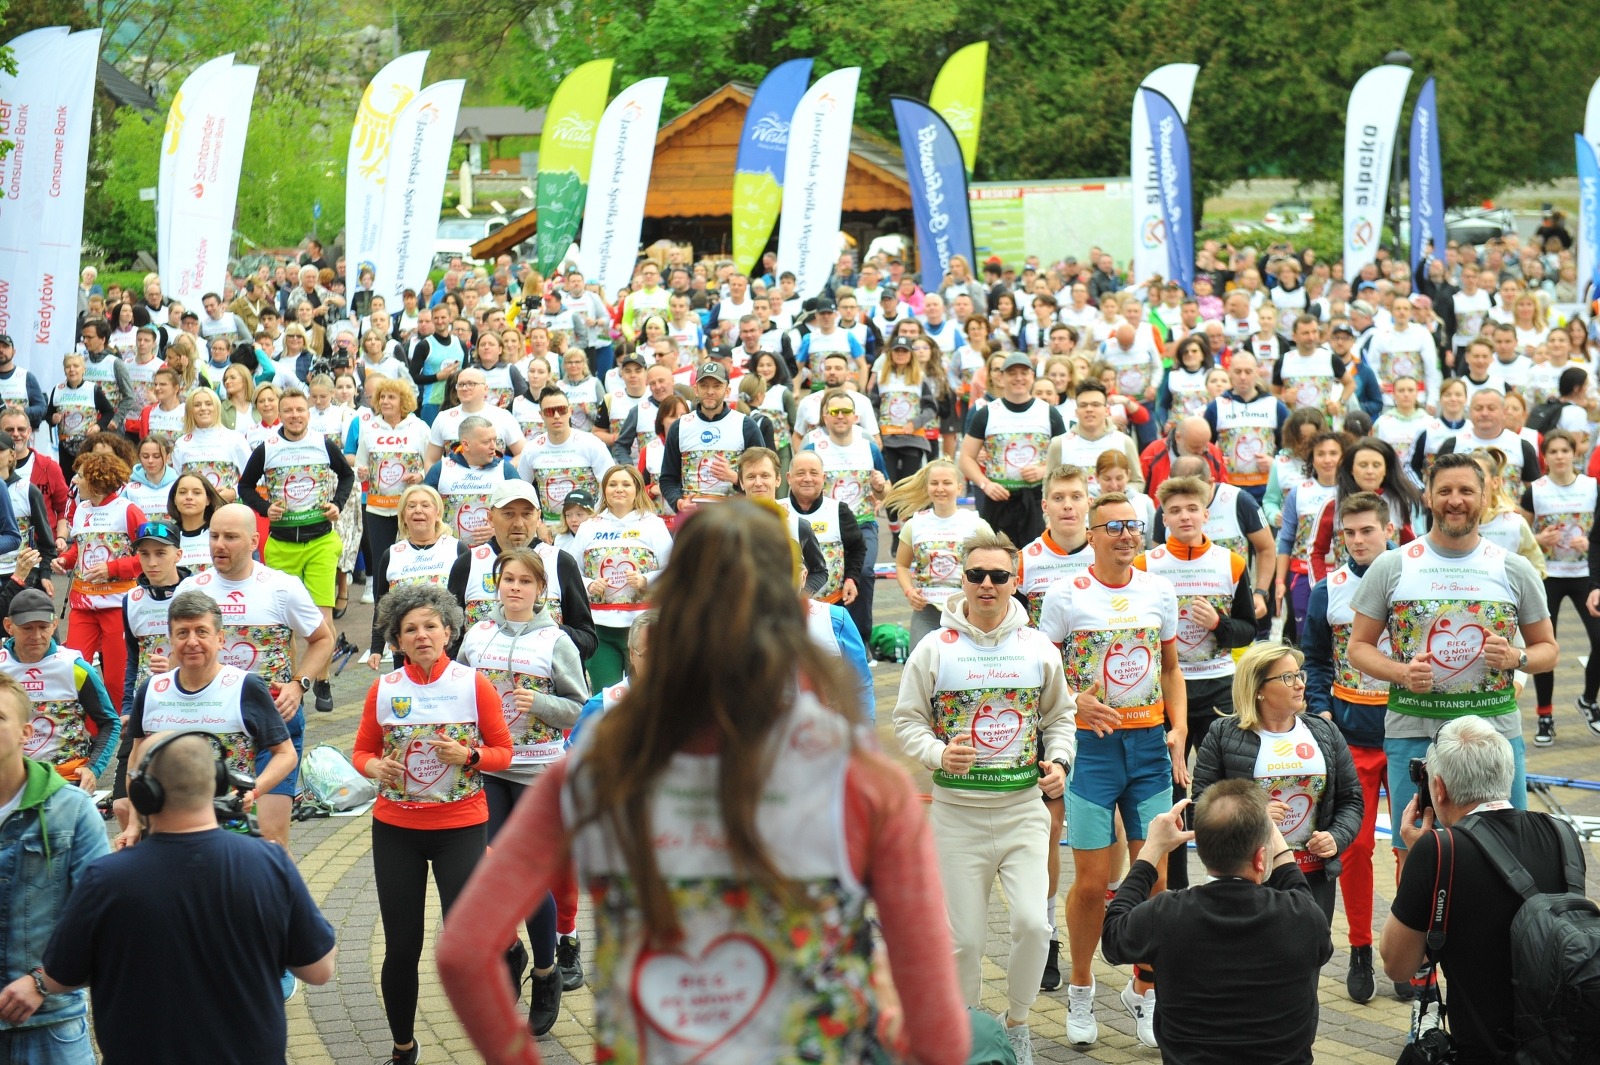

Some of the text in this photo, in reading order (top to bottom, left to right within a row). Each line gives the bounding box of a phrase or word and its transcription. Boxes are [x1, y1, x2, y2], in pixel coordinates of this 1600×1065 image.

[8, 103, 29, 200] Consumer Bank
[49, 104, 68, 198] Consumer Bank
[193, 113, 215, 181] Santander
[36, 273, 56, 344] Kredytów
[462, 472, 482, 481] Hotel
[813, 524, 825, 532] 24
[1413, 546, 1420, 556] 6
[412, 554, 434, 564] Hotel
[1419, 567, 1489, 576] POLSKĄ TRANSPLANTOLOGIĘ
[134, 590, 142, 598] 10
[221, 605, 244, 613] RLEN
[1108, 615, 1139, 625] polsat
[1451, 647, 1476, 655] NOWE
[1444, 654, 1470, 663] ŻYCIE
[1125, 666, 1144, 674] NOWE
[966, 669, 985, 684] Jerzy
[1119, 672, 1140, 680] ŻYCIE
[158, 680, 167, 690] 10
[616, 689, 622, 698] 8
[1420, 699, 1433, 708] dla
[1126, 710, 1151, 719] NOWE
[994, 728, 1015, 736] NOWE
[988, 734, 1010, 743] ŻYCIE
[1267, 761, 1304, 772] polsat
[962, 772, 974, 781] dla
[1435, 889, 1447, 922] Canon
